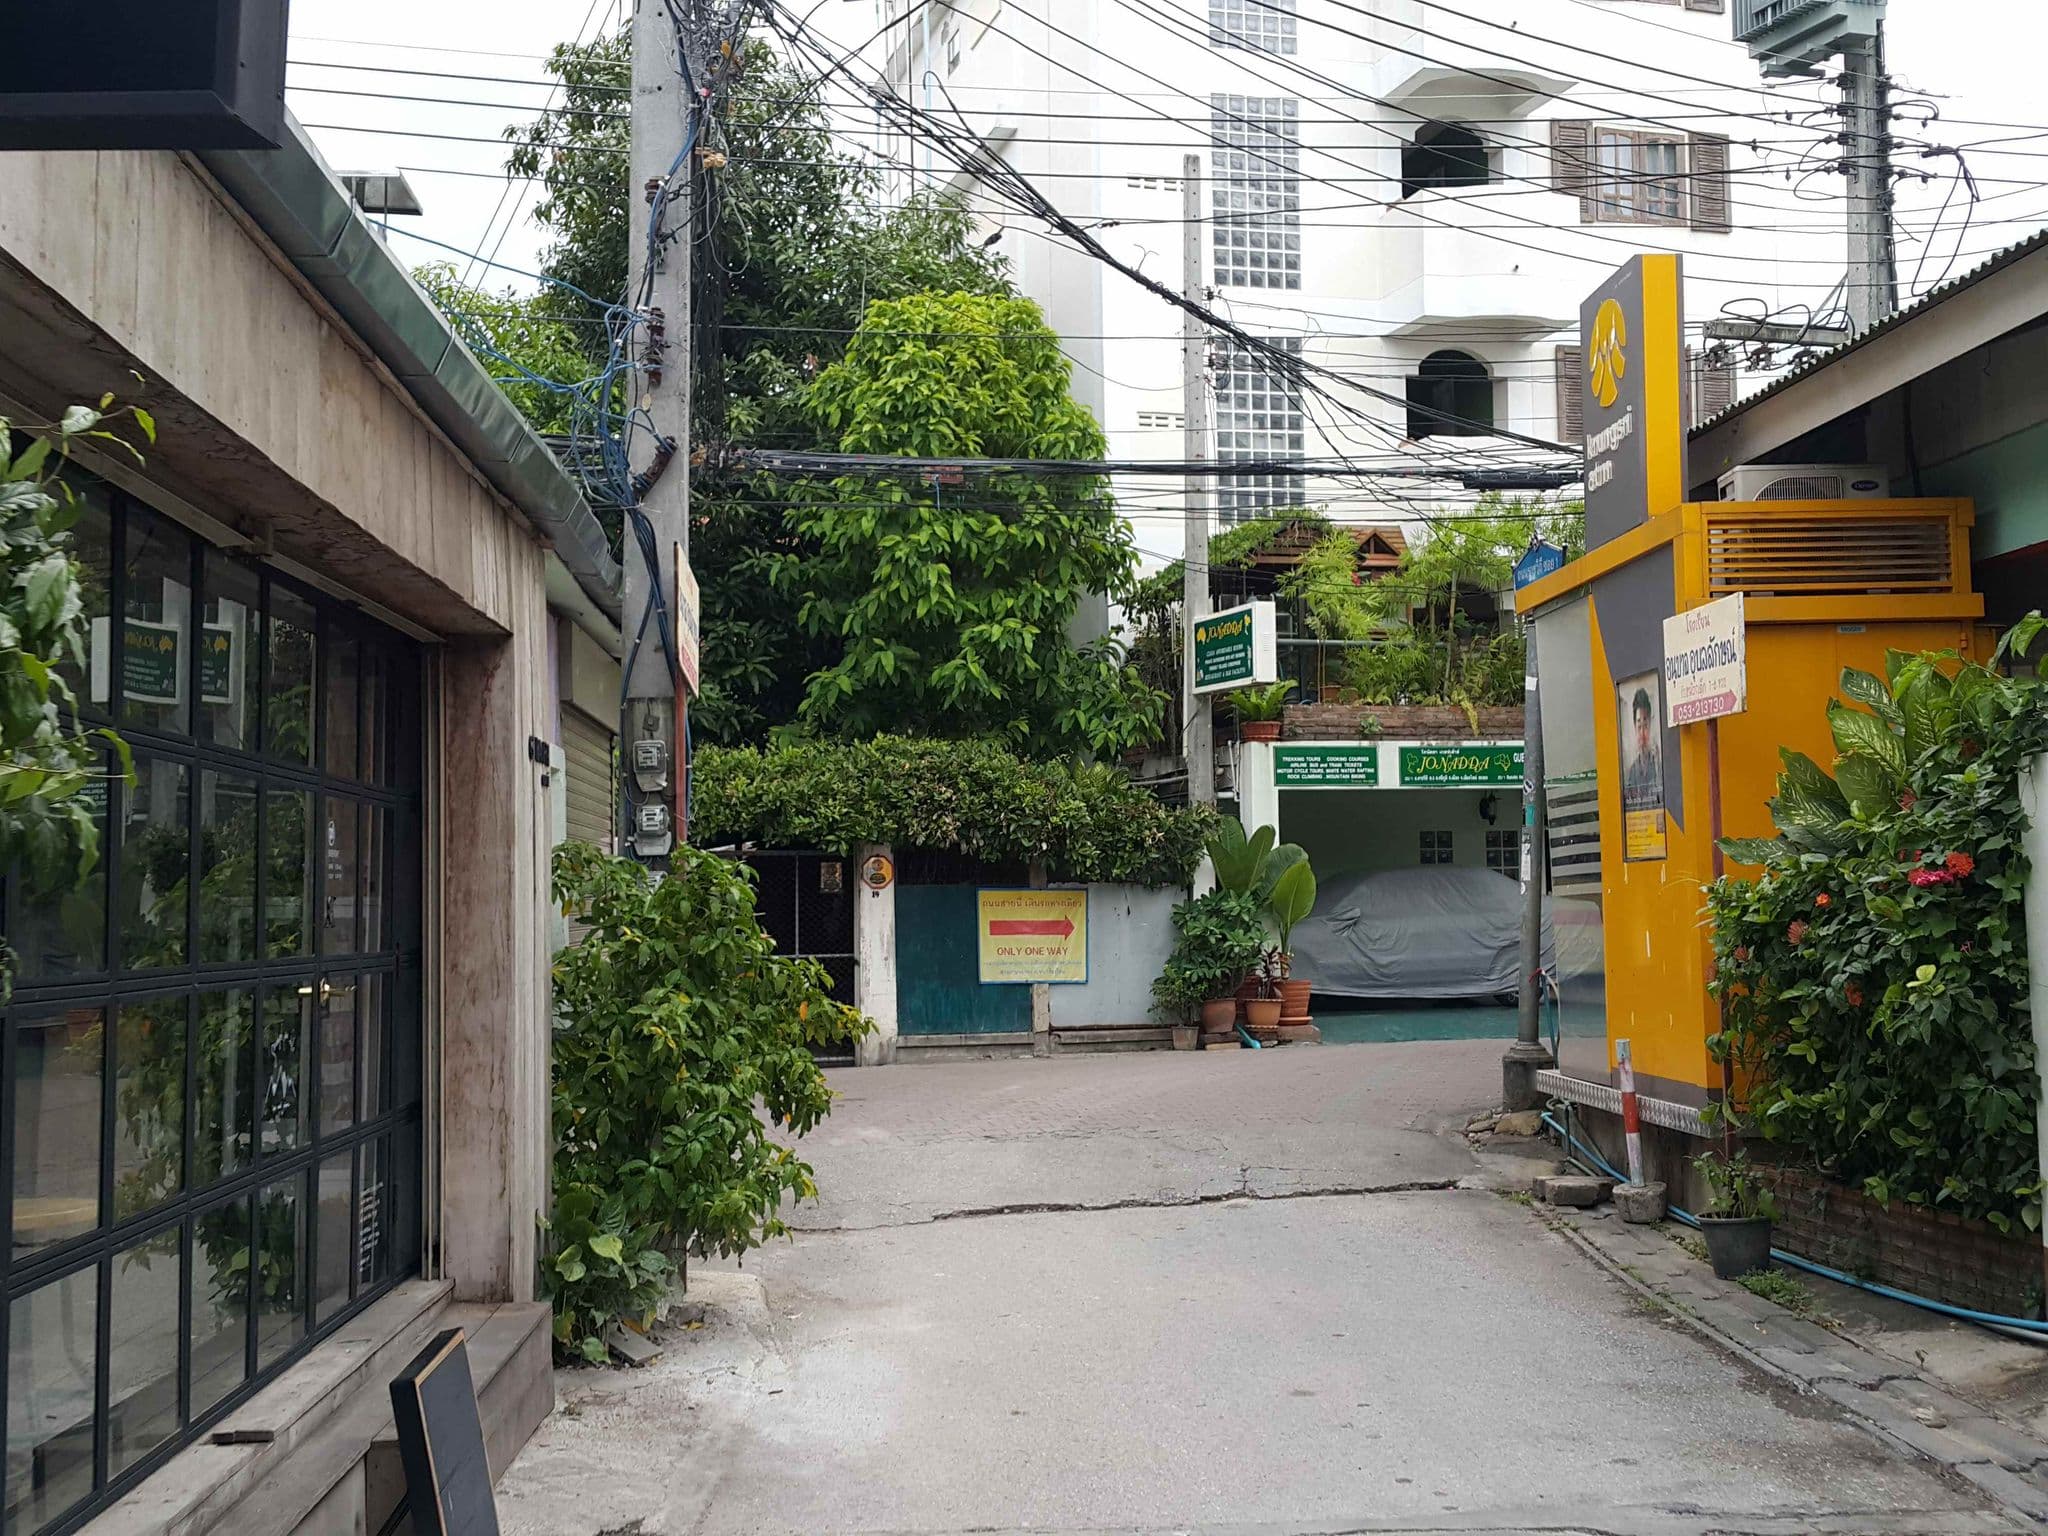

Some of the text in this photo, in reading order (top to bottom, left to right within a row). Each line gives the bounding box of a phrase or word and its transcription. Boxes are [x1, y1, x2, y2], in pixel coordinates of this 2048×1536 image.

[1587, 459, 1613, 492] atm
[1665, 651, 1689, 688] อนุบาล
[1678, 697, 1725, 720] 053-213730
[1416, 753, 1525, 773] JONADDA GUE
[996, 947, 1069, 956] ONLY ONE WAY
